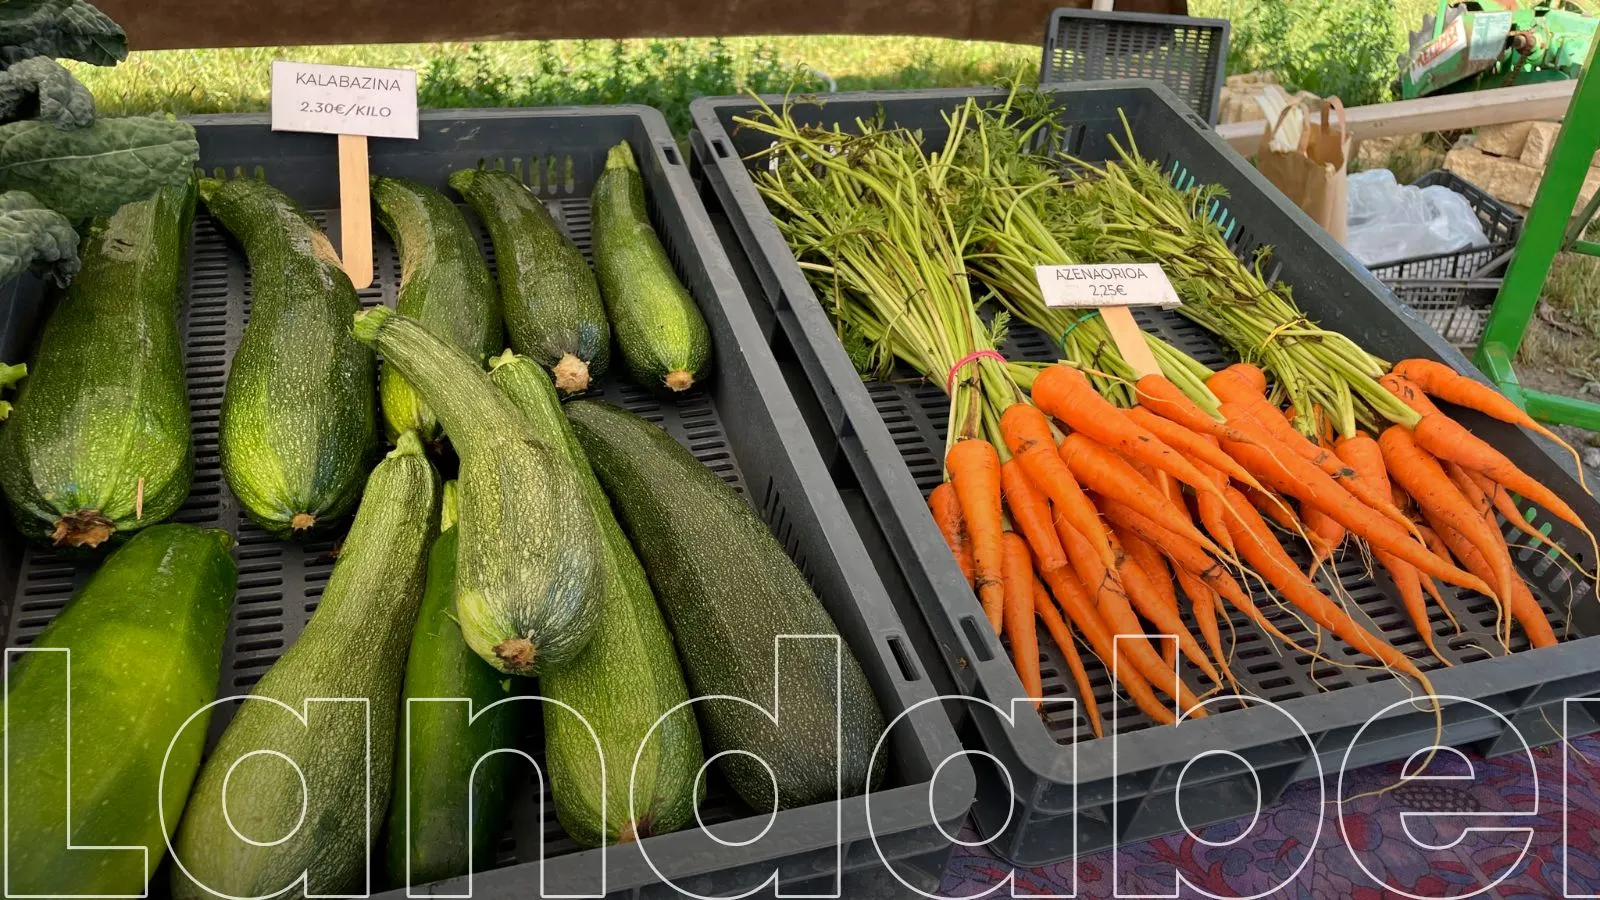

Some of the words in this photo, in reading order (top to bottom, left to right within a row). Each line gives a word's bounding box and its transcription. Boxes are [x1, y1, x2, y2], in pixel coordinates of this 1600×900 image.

[296, 72, 401, 91] KALABAZINA
[300, 101, 392, 118] 2.30€/KILO
[1056, 267, 1148, 281] AZENAORIOA
